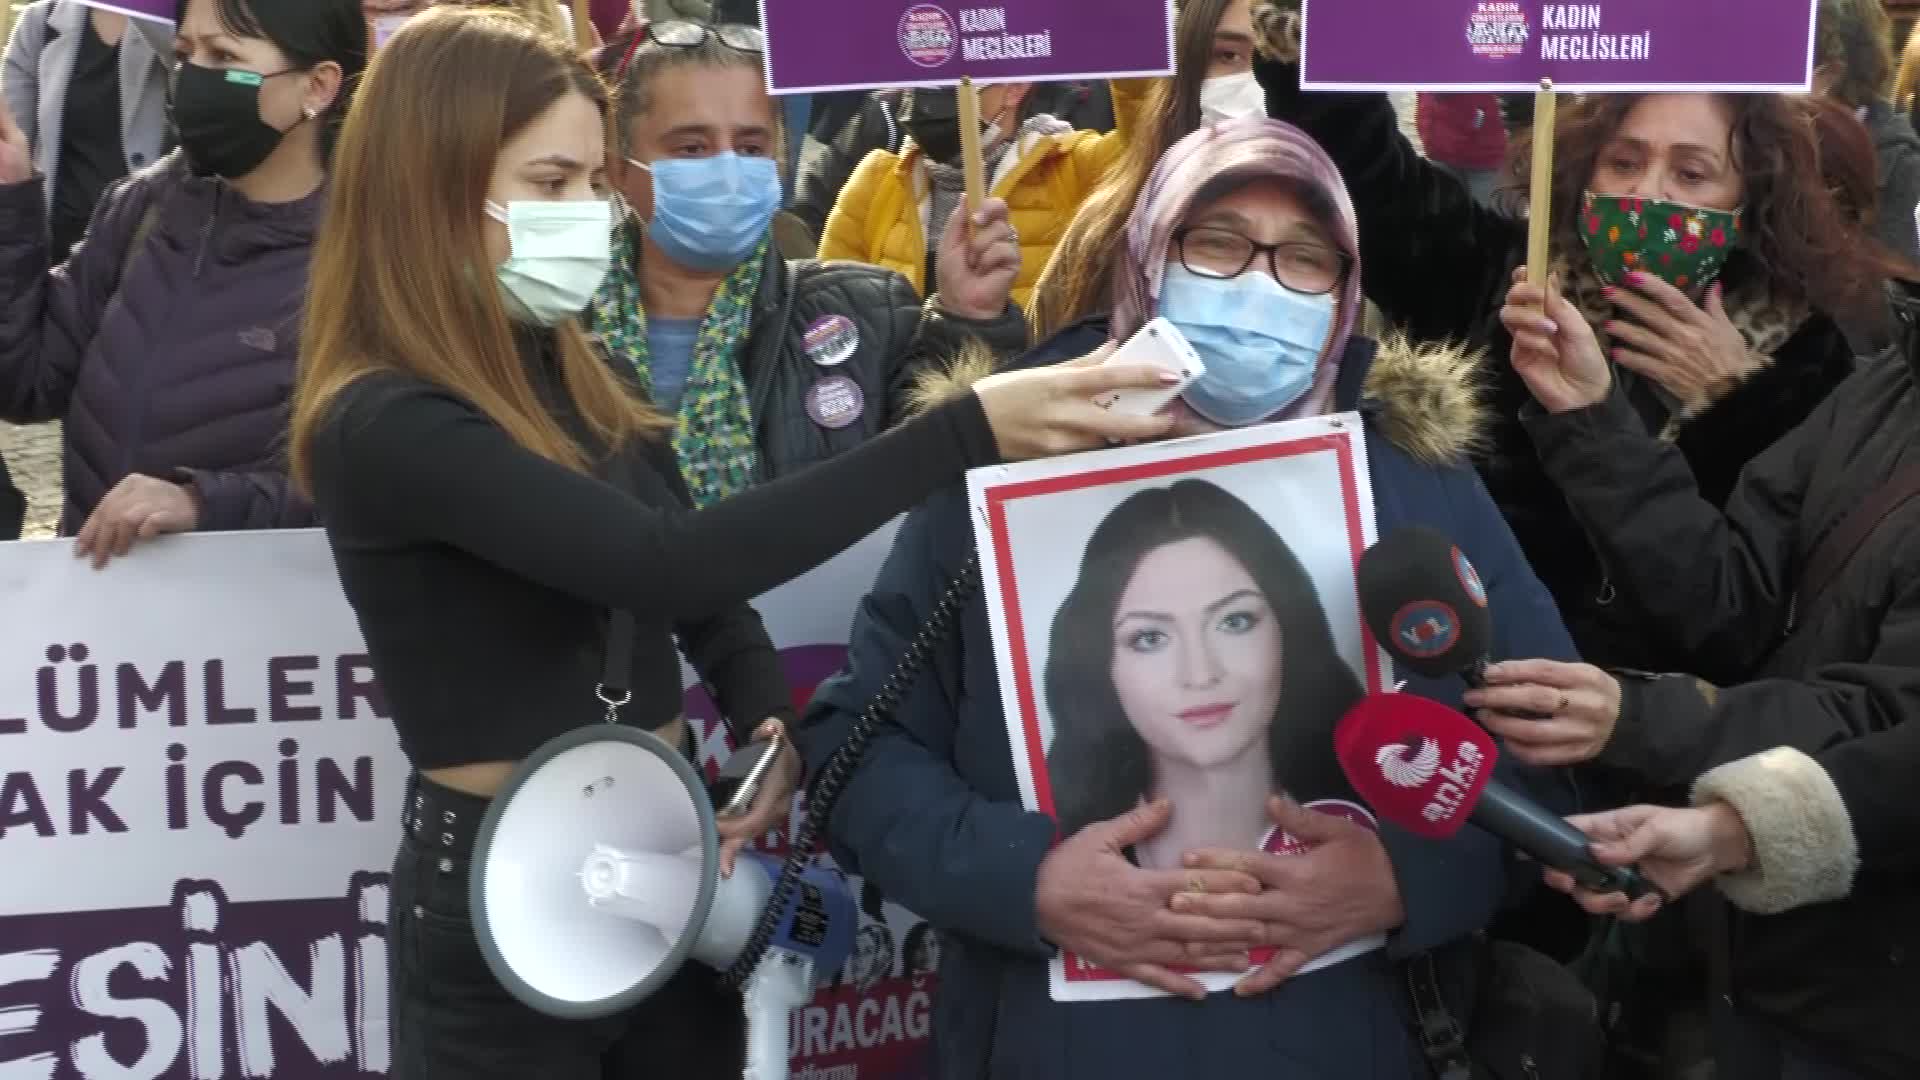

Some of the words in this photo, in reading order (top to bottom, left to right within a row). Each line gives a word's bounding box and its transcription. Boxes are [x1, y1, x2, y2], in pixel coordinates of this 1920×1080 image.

[960, 7, 1006, 32] KADIN
[1541, 4, 1601, 29] KADIN
[962, 29, 1052, 61] MECLİSLERİ
[1541, 31, 1651, 60] MECLİSLERİ
[0, 766, 130, 839] AK
[165, 738, 375, 839] İÇİN
[1422, 741, 1479, 822] anka
